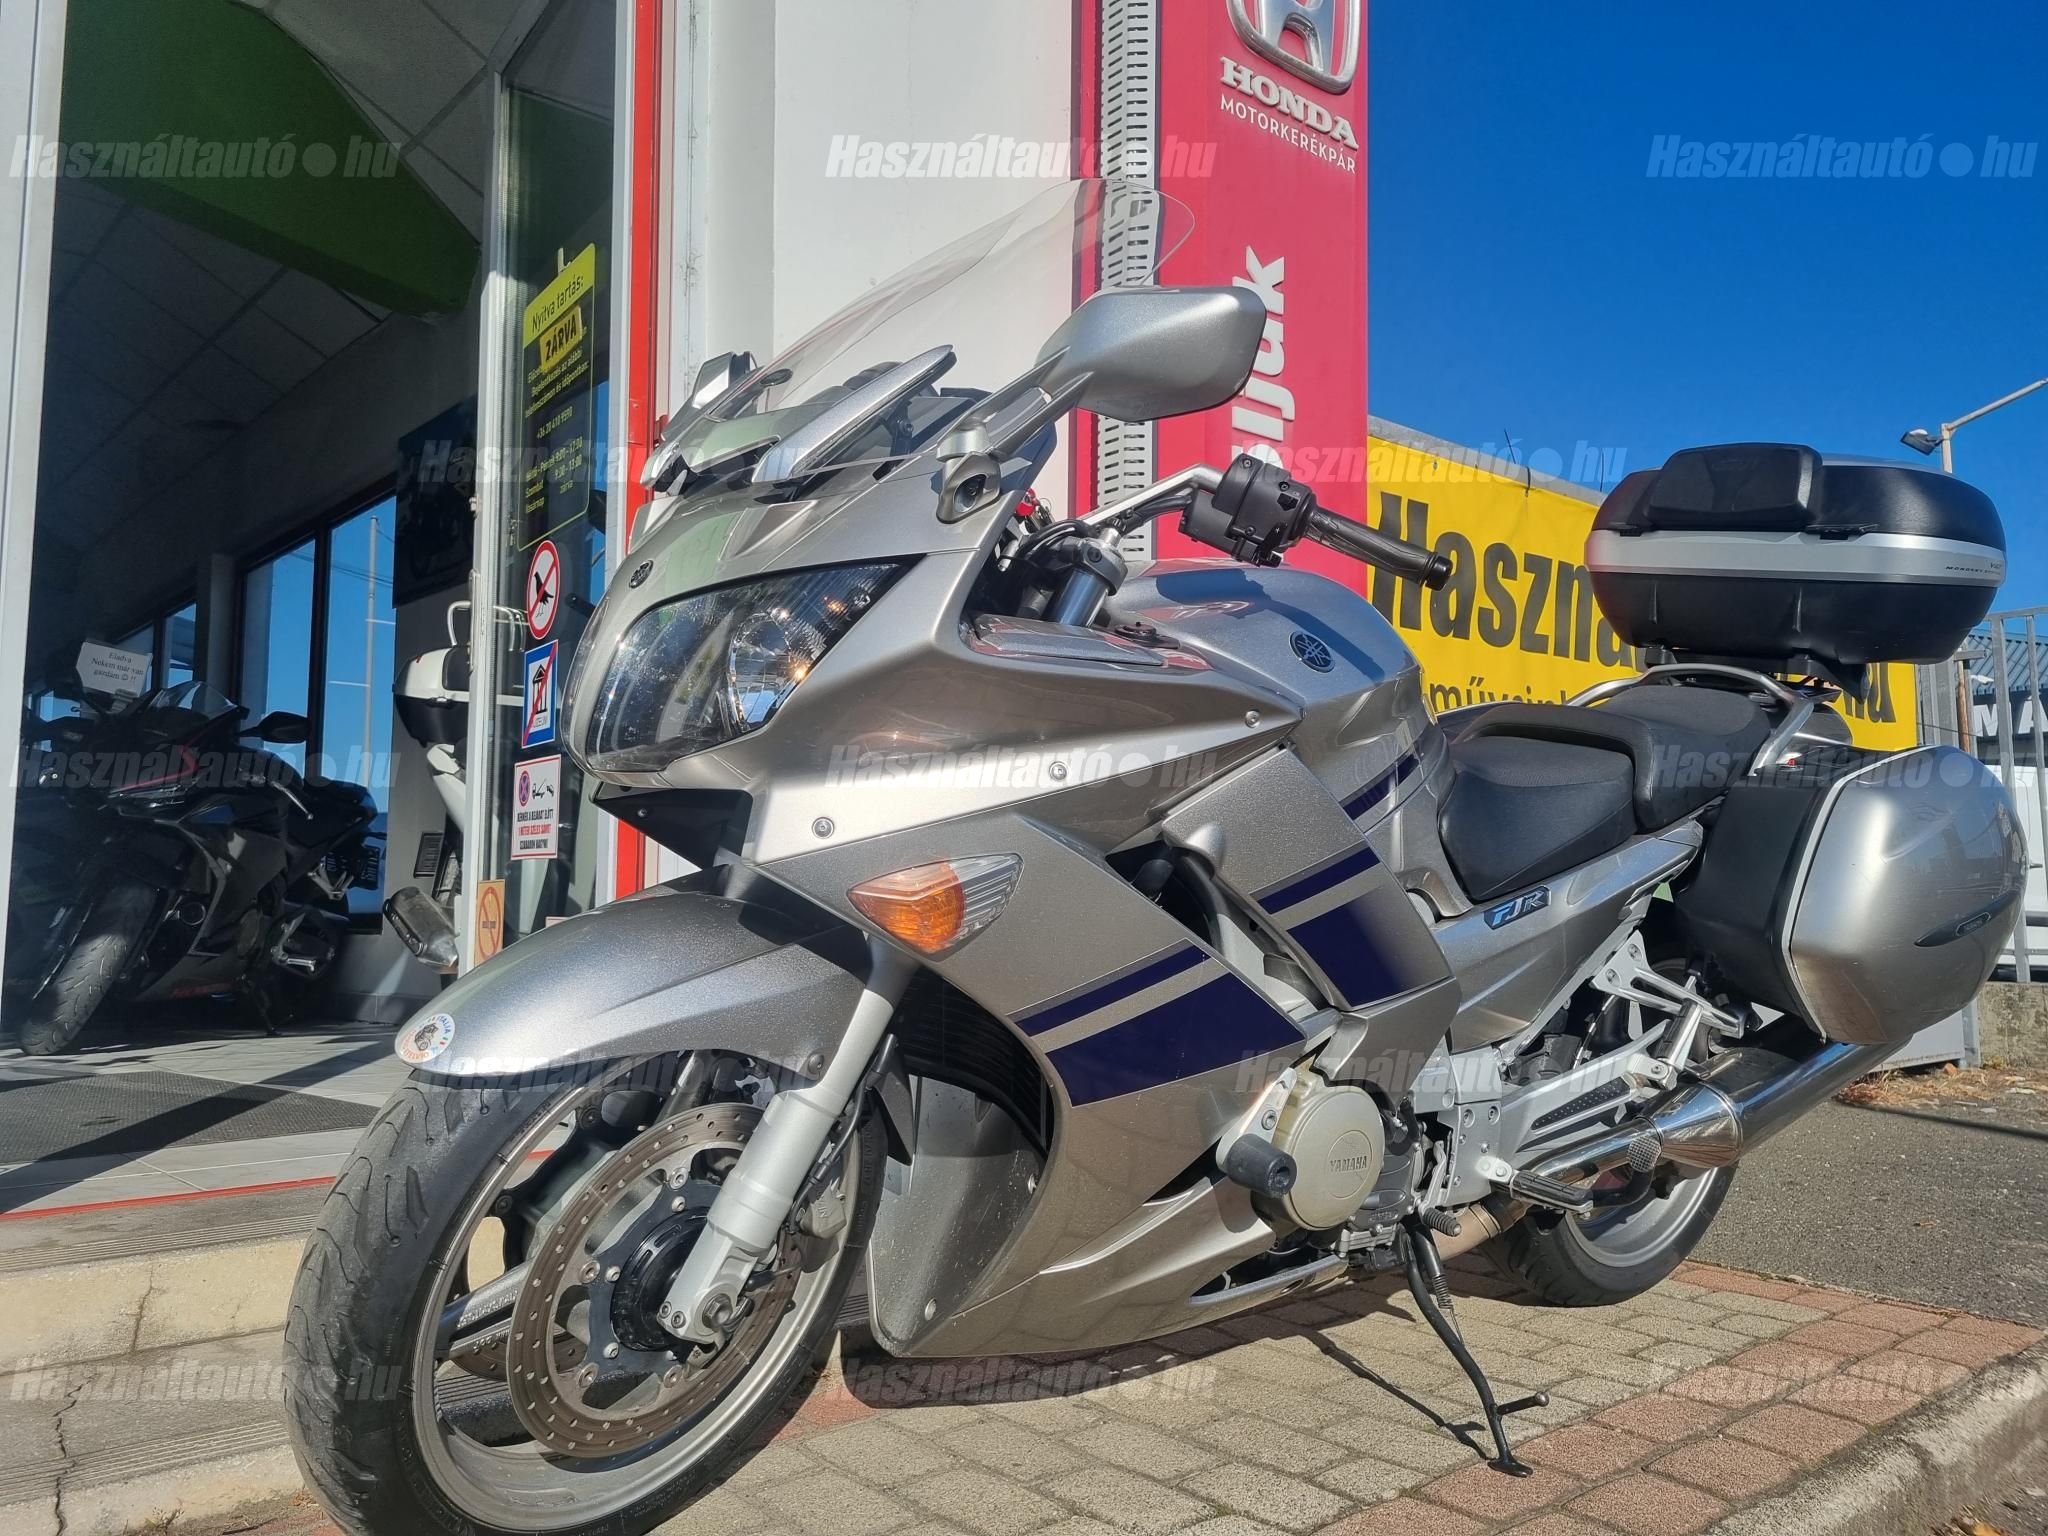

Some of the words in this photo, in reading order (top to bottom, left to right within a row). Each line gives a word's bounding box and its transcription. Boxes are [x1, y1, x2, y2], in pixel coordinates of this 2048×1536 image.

[1220, 56, 1359, 151] HONDA
[1221, 93, 1356, 174] MOTORKERÉKPÁR
[532, 300, 555, 332] Nyitva
[545, 314, 577, 362] ZÁRVA
[1491, 890, 1545, 927] FJR
[1330, 1155, 1367, 1172] YAMAHA
